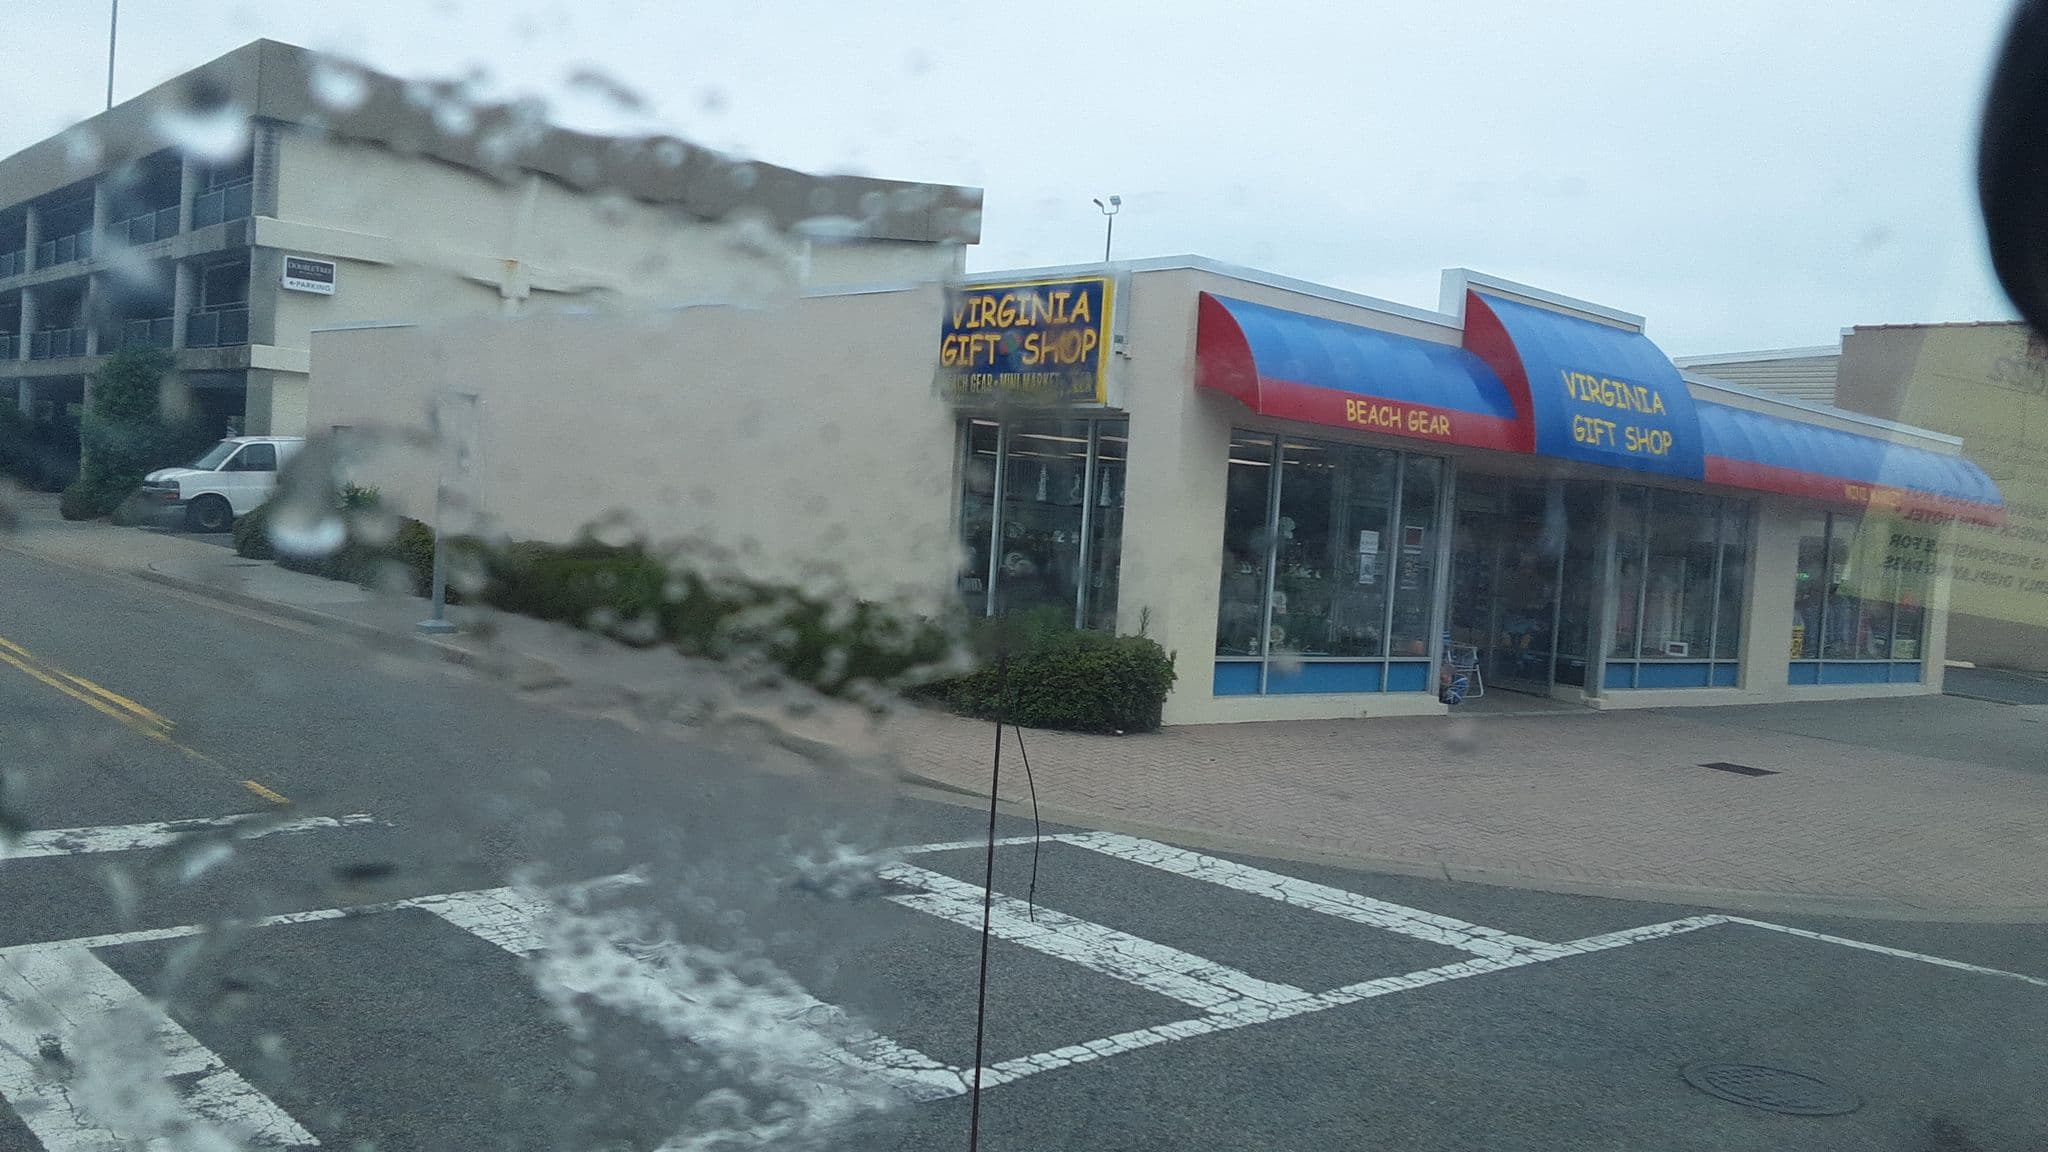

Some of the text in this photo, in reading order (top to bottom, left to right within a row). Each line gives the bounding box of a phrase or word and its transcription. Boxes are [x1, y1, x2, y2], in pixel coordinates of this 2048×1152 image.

[296, 281, 332, 292] PARKING
[949, 290, 1091, 330] VIRGINIA
[940, 328, 1097, 367] GIFT SHOP
[970, 373, 993, 393] GEAR
[1561, 369, 1666, 416] VIRGINIA
[1346, 398, 1450, 435] BEACH GEAR
[1573, 414, 1672, 456] GIFT SHOP
